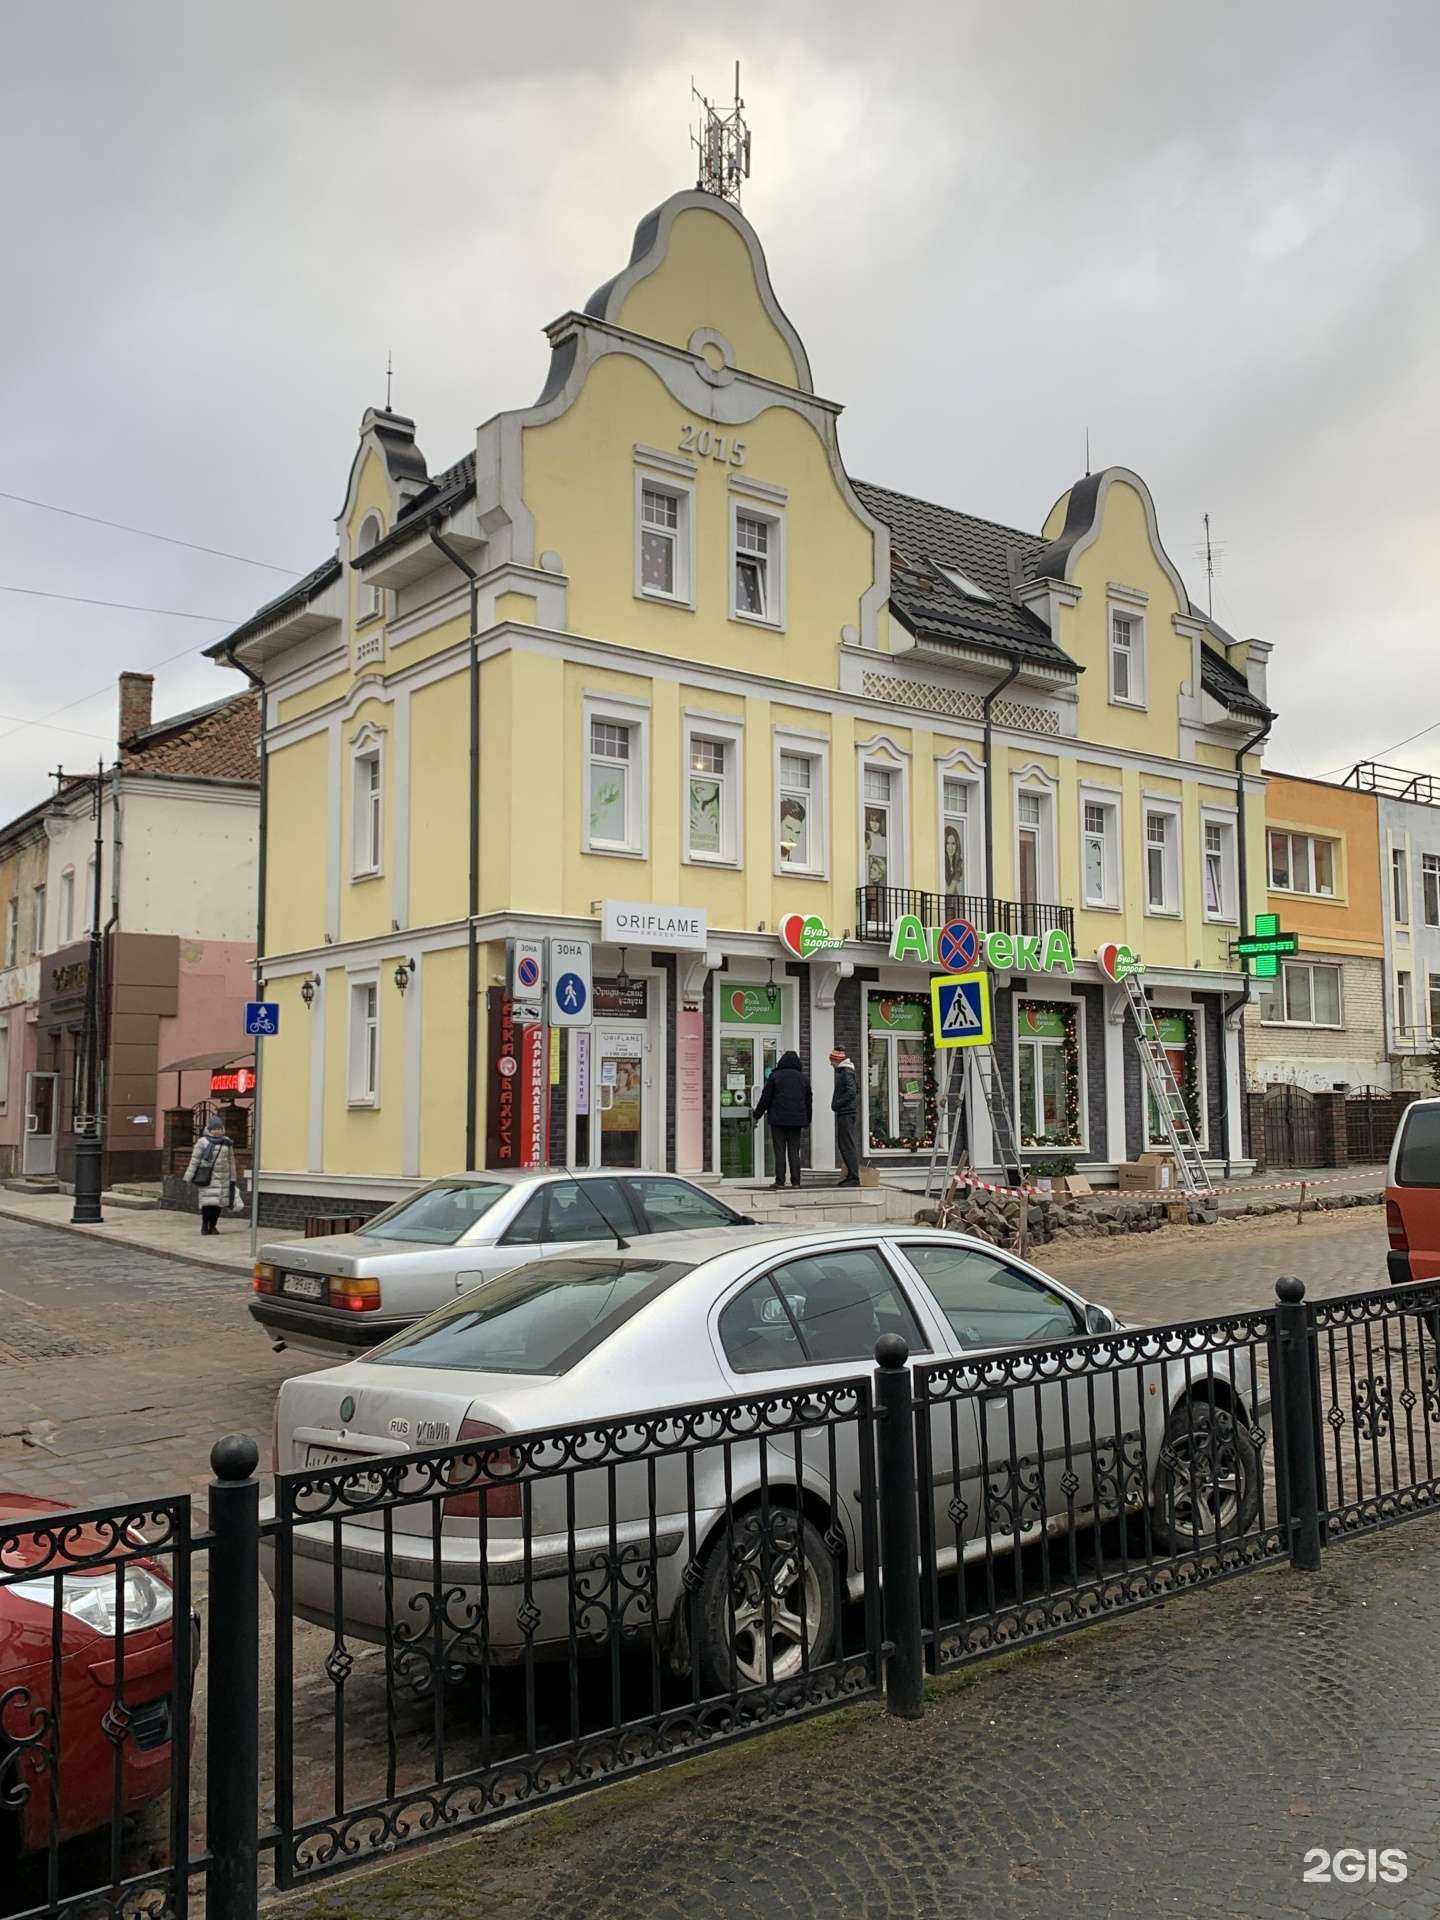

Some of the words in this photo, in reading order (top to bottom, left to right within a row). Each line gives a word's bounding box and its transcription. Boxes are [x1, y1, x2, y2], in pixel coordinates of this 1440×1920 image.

[679, 425, 746, 468] 2015
[616, 915, 699, 933] ORIFLAME
[803, 926, 829, 938] Будь
[521, 944, 537, 952] ЗОНА
[557, 944, 582, 955] ЗОНА
[532, 1030, 543, 1160] ПАРИКМАХЕРСКАЯ
[390, 1420, 408, 1434] RUS
[416, 1421, 450, 1441] OCTAVIA
